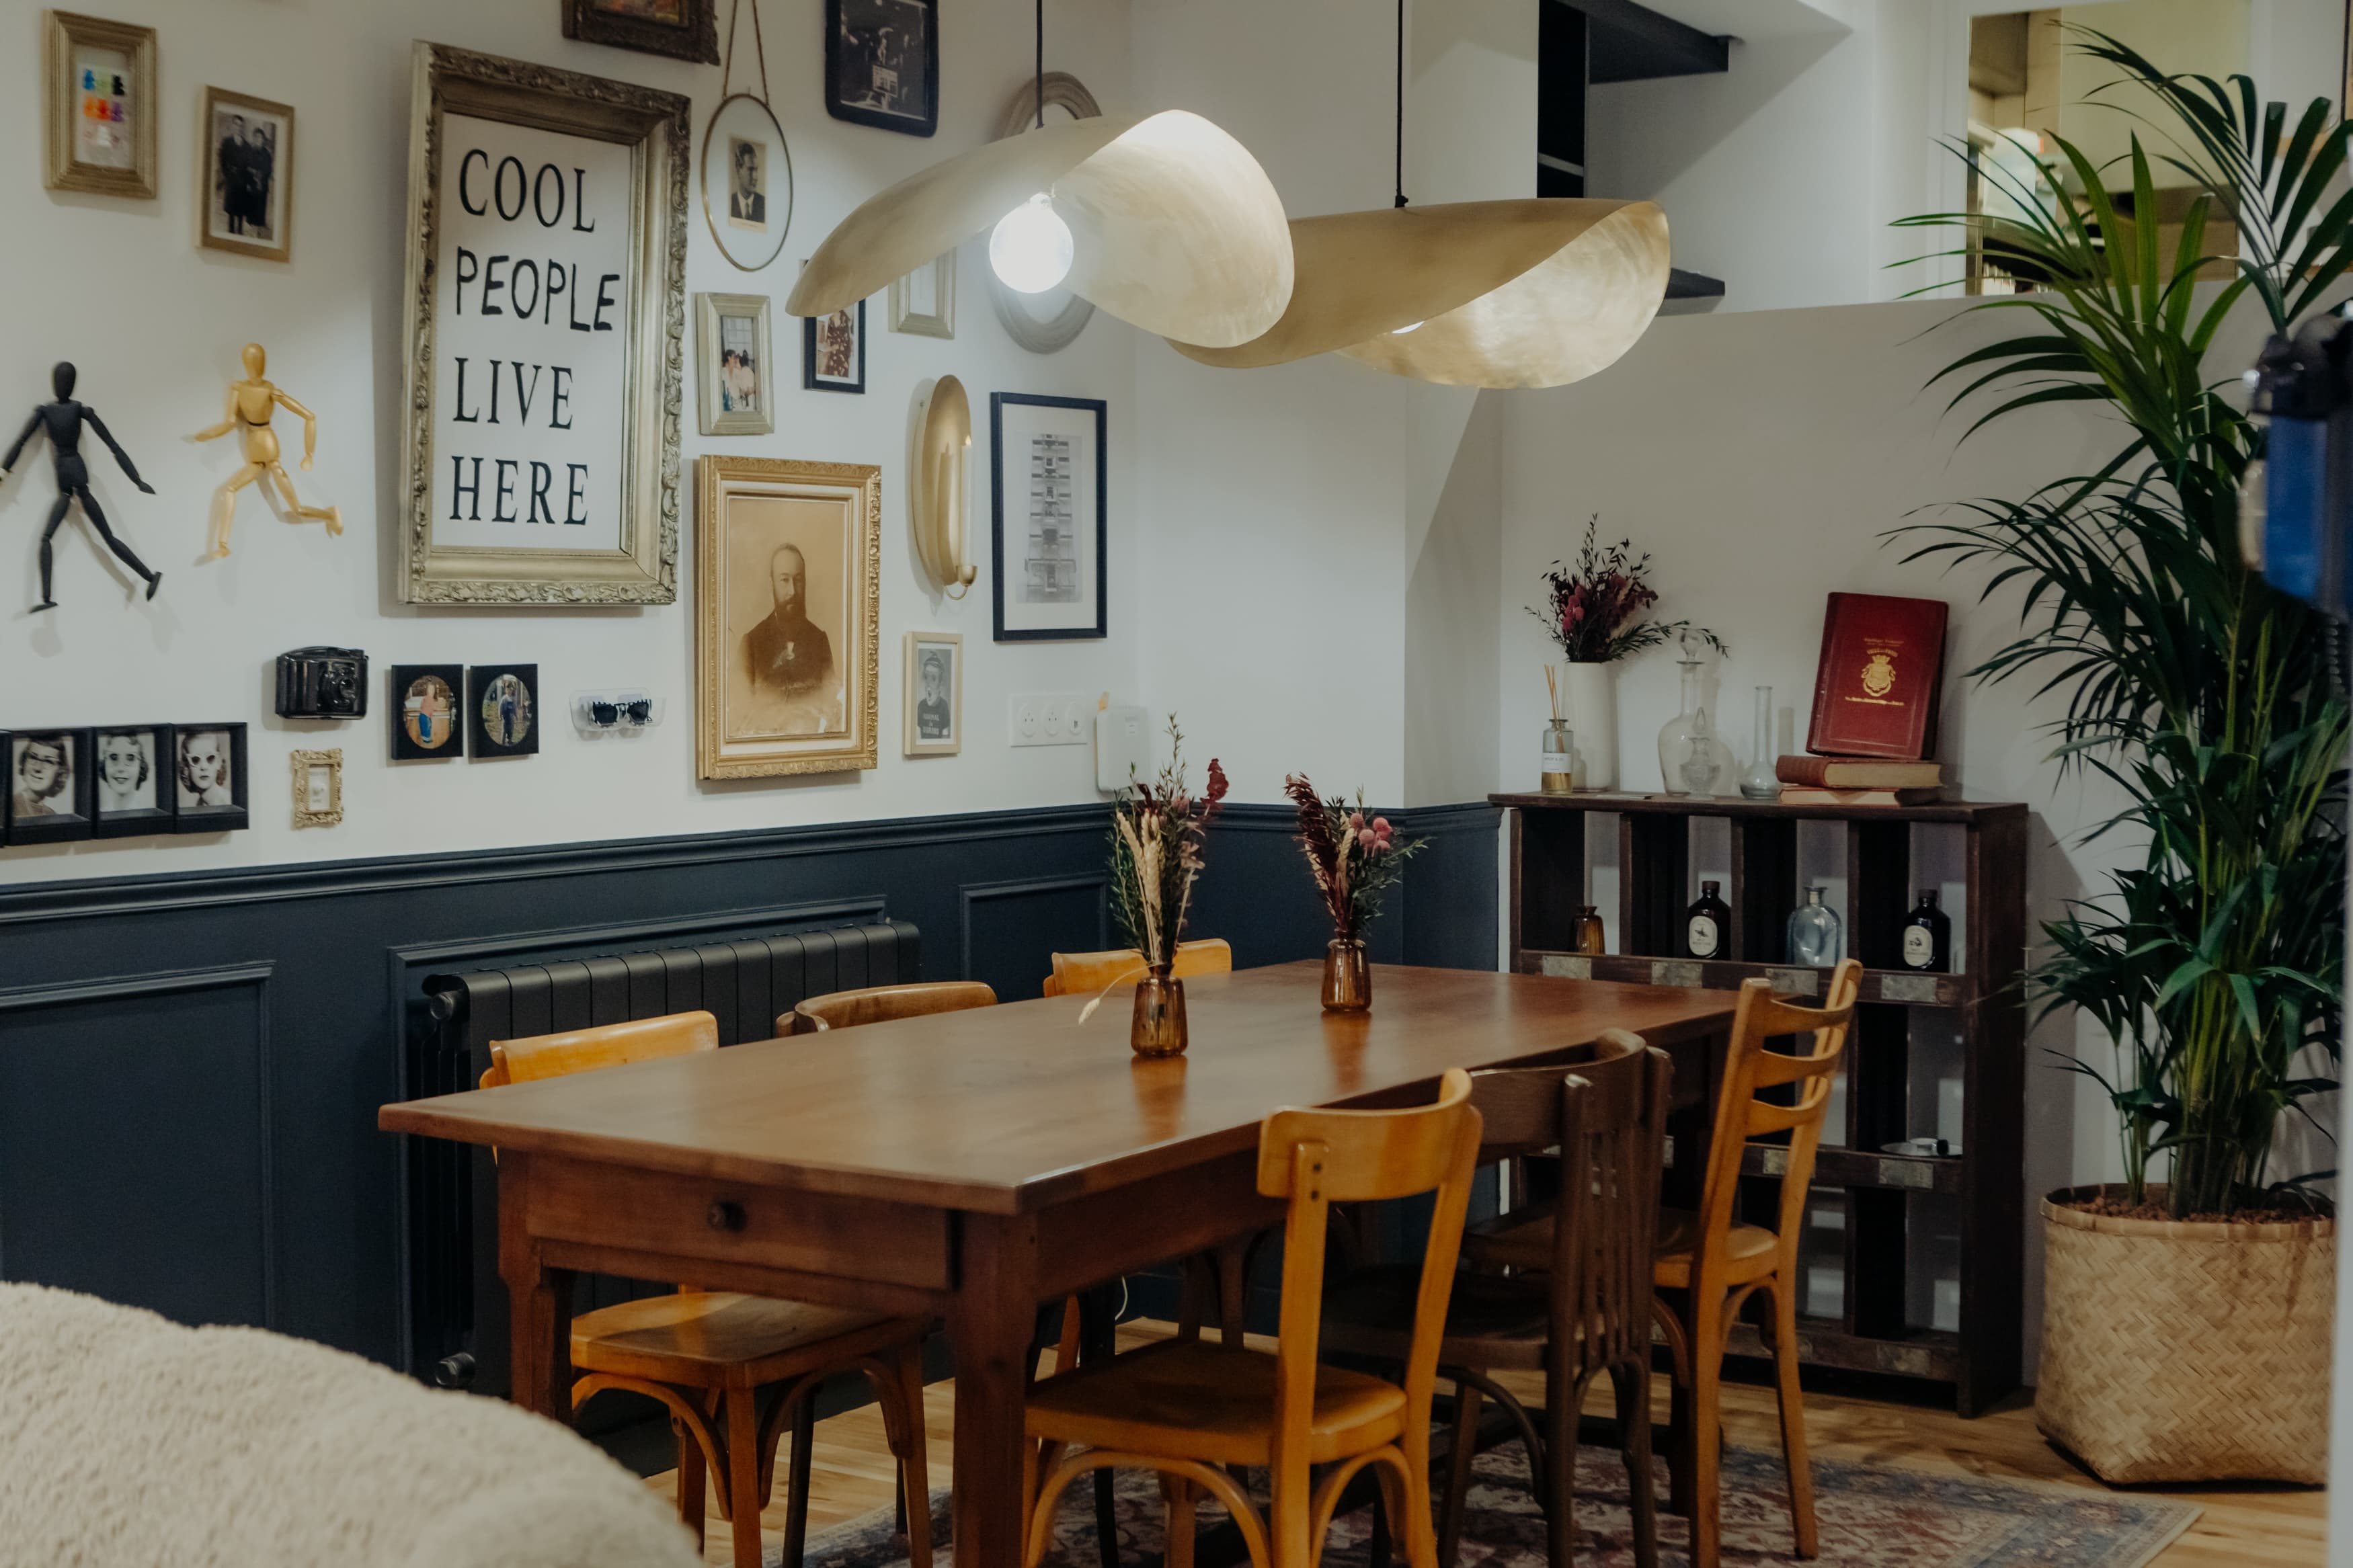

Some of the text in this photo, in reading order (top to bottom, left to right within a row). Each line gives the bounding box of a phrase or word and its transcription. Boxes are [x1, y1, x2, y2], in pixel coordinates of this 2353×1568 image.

[458, 149, 596, 233] COOL
[456, 246, 620, 332] PEOPLE
[452, 357, 573, 430] LIVE
[449, 456, 589, 526] HERE
